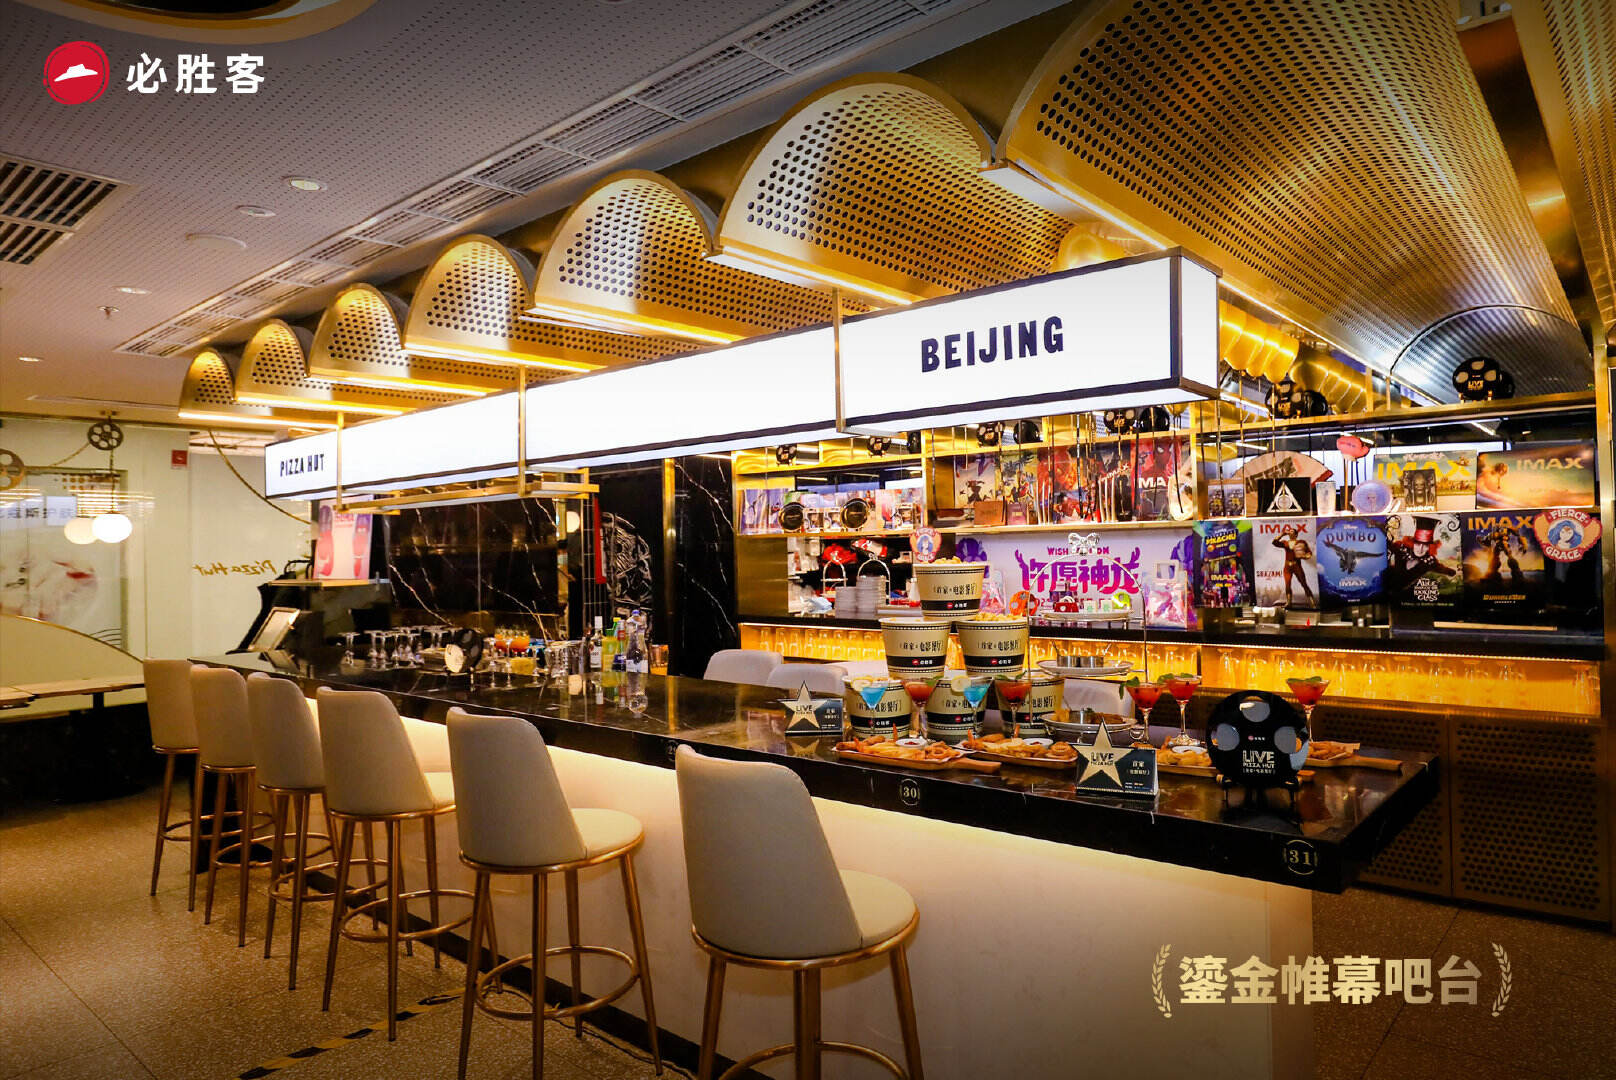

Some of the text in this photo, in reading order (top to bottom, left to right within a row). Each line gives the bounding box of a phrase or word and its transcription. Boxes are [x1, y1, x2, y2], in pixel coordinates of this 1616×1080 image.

[921, 316, 1064, 373] BEIJING
[280, 453, 324, 477] PIZZA HUT
[1516, 457, 1584, 471] IMAX
[1551, 508, 1587, 522] FIERCE
[1259, 523, 1308, 534] IMAX
[1468, 515, 1534, 531] IMAX
[1325, 532, 1377, 543] DUMBO
[1047, 546, 1069, 556] WISH
[1545, 545, 1581, 560] GRACE
[1338, 578, 1367, 587] IMAX
[795, 704, 812, 712] LIVE
[1090, 752, 1115, 762] LIVE
[1242, 750, 1275, 763] LIVE
[903, 786, 917, 799] 30
[1289, 849, 1312, 866] 31
